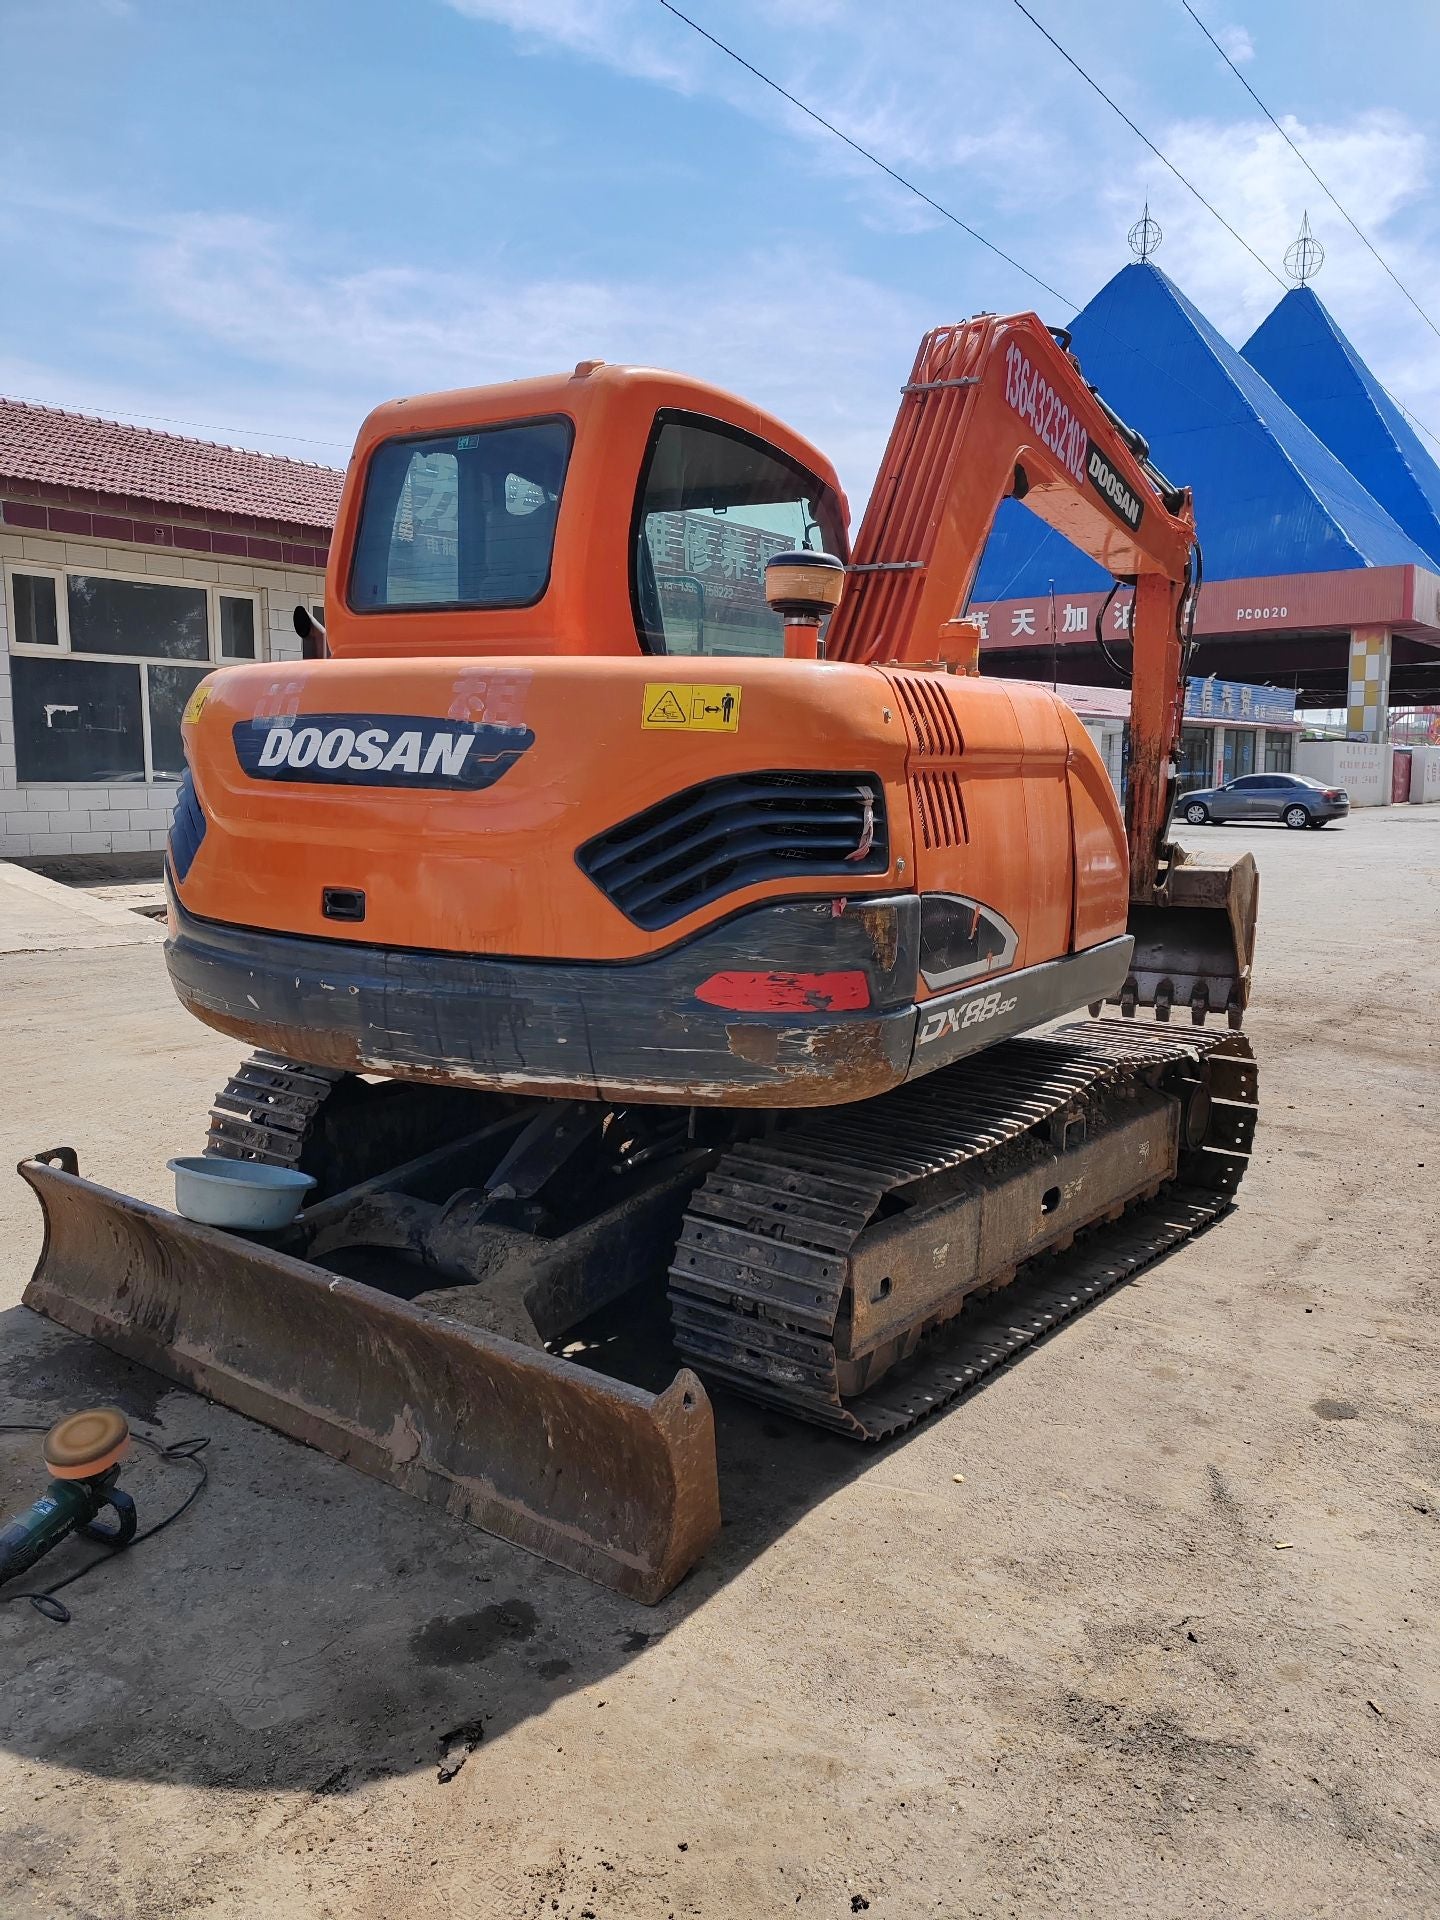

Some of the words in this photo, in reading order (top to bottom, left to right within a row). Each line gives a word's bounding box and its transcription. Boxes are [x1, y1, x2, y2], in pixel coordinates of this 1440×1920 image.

[1005, 341, 1088, 484] 13643232102
[1088, 451, 1140, 524] DOOSAN
[1237, 606, 1288, 621] PC0020
[258, 727, 475, 776] DOOSAN
